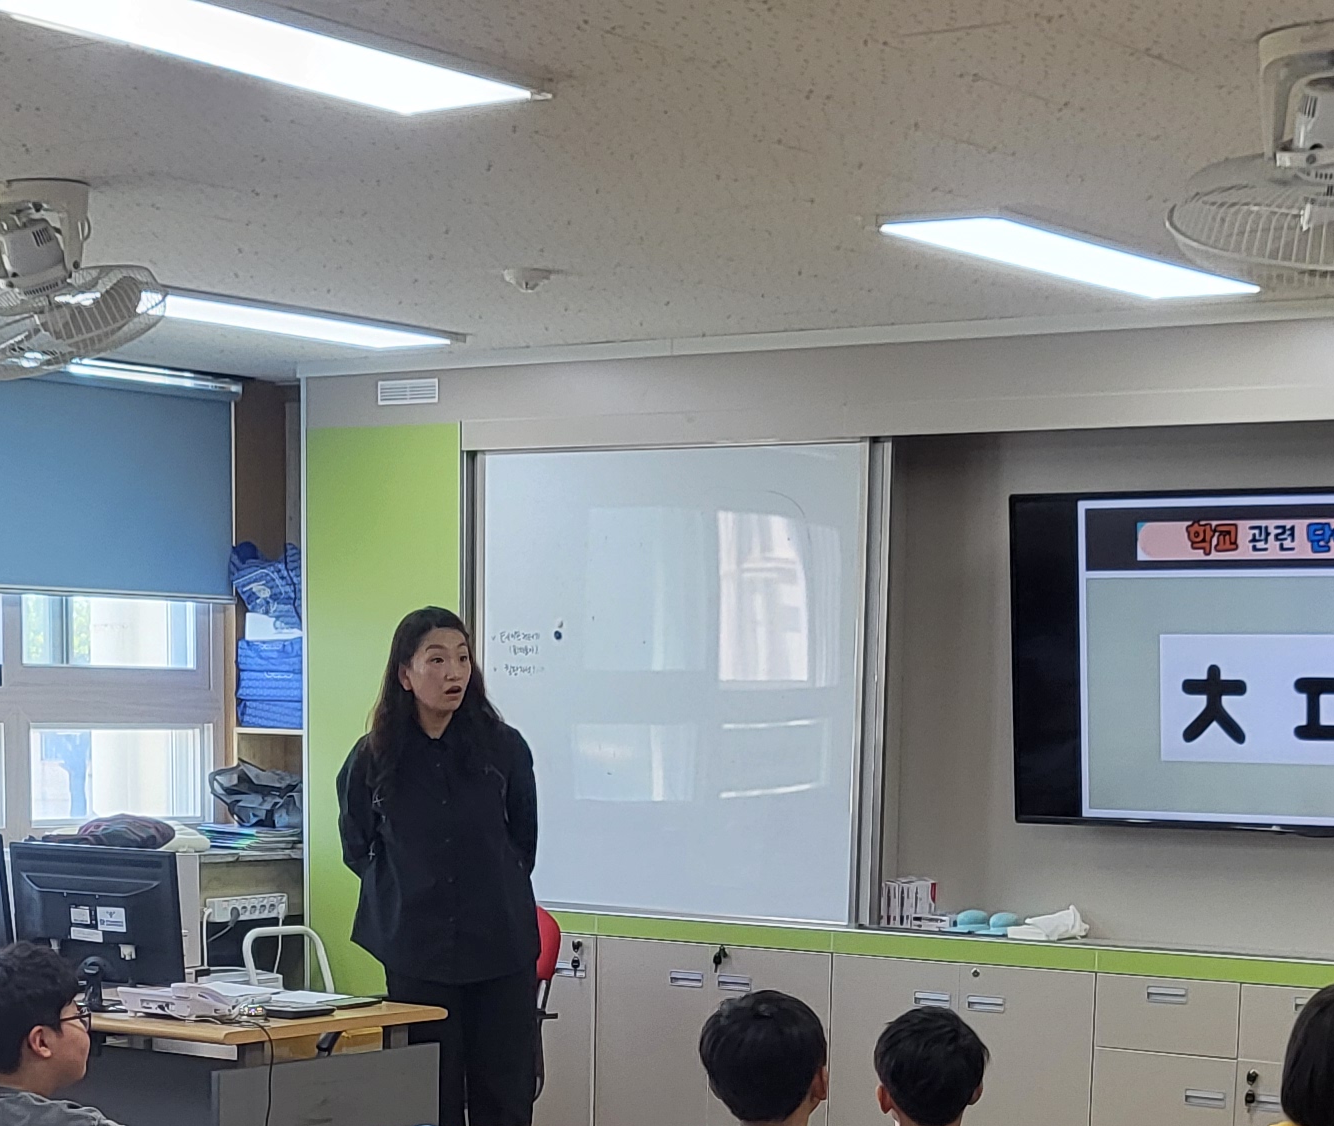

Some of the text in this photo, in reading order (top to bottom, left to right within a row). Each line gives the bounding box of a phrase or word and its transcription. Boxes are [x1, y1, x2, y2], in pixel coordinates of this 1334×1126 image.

[1186, 520, 1238, 556] 학교
[1248, 525, 1295, 552] 관련
[1182, 664, 1247, 744] ㅊ
